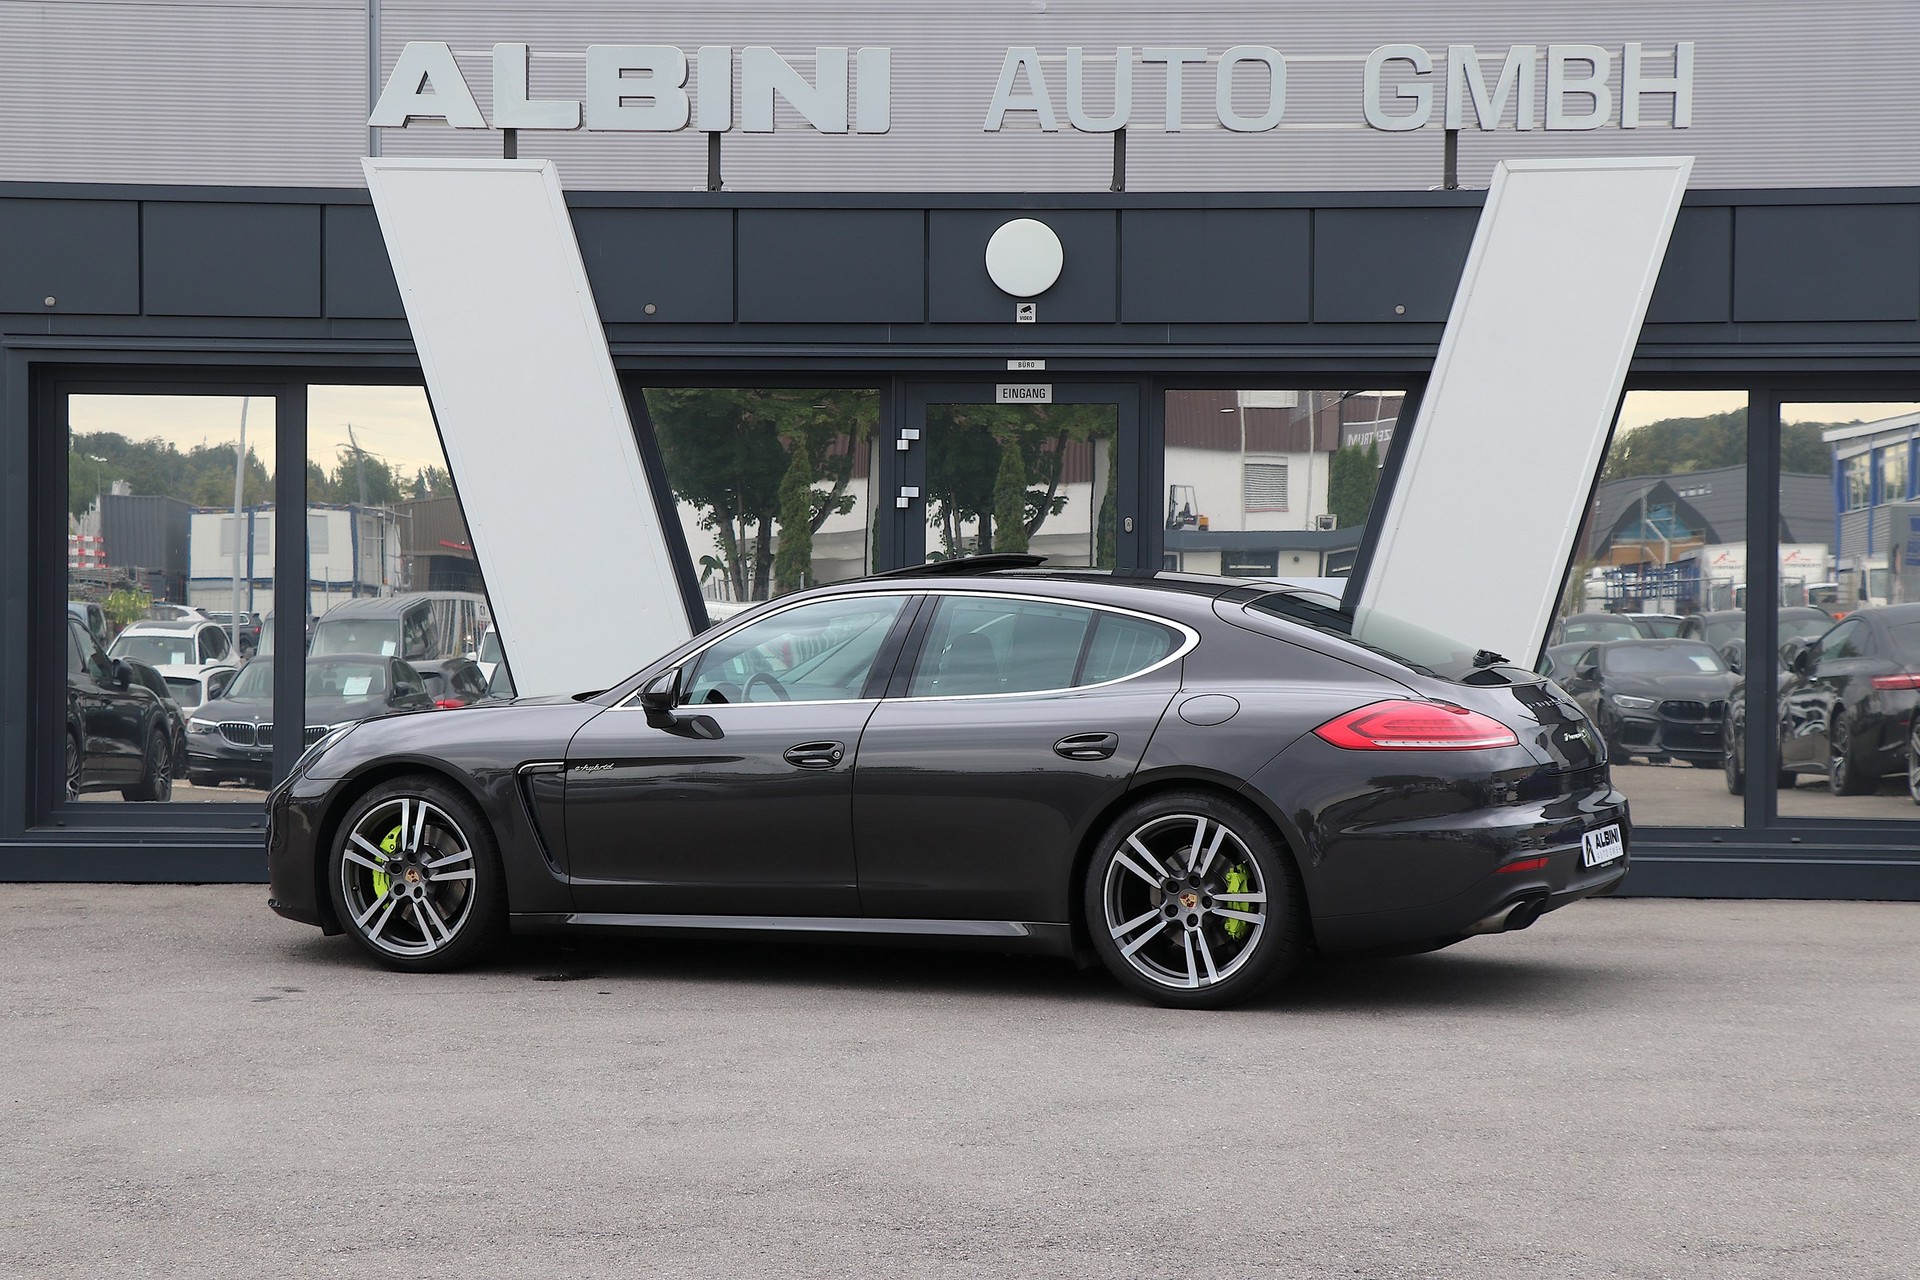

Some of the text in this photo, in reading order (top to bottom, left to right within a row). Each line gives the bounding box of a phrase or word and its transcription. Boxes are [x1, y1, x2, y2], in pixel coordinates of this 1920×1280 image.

[366, 41, 1694, 134] ALBINI AUTO GMBH
[1003, 388, 1046, 399] EINGANG
[1596, 828, 1620, 849] ALBINI
